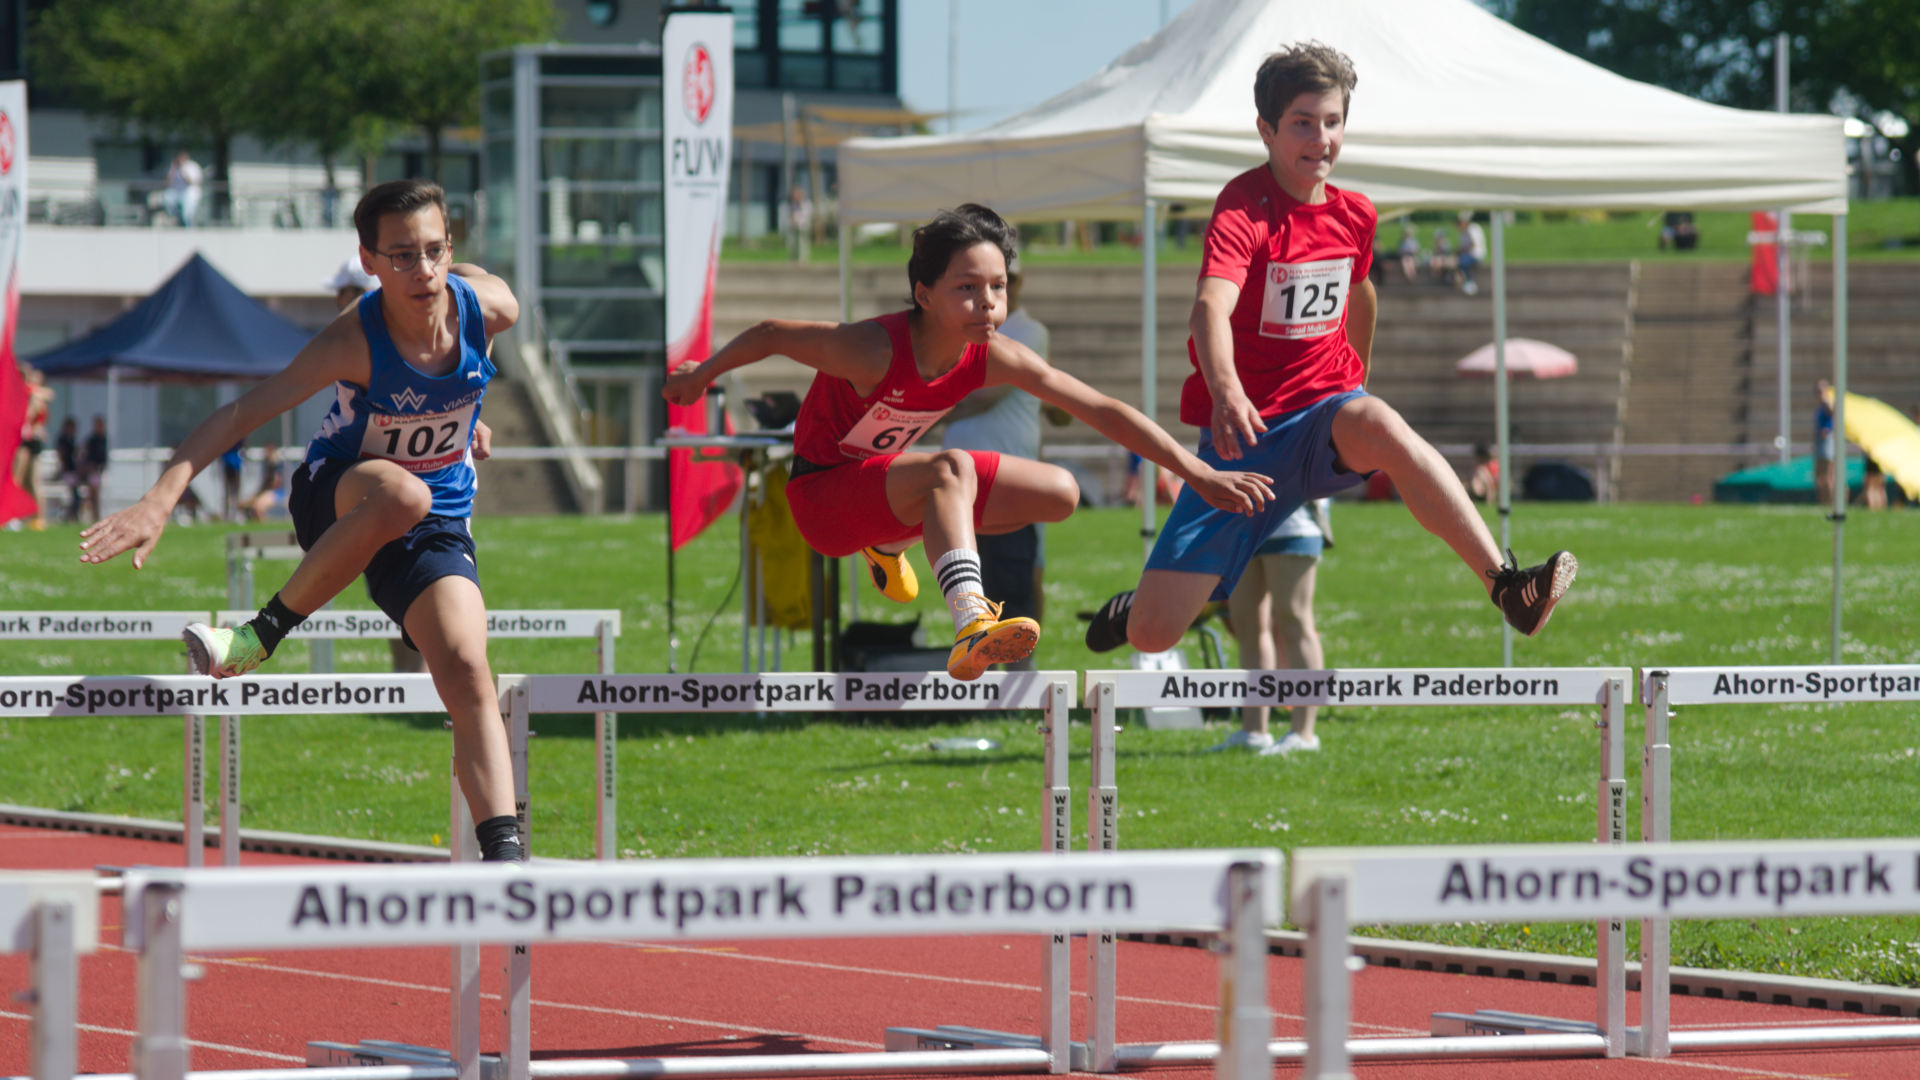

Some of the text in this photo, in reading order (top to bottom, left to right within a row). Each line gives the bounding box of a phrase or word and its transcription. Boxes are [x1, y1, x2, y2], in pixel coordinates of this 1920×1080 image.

[1281, 282, 1339, 320] 125
[383, 421, 458, 457] 102
[872, 426, 921, 450] 61
[39, 616, 153, 633] Paderborn
[487, 616, 566, 632] derborn
[0, 681, 405, 713] orn-Sportpark Paderborn
[577, 677, 1000, 708] Ahorn-Sportpark Paderborn
[1161, 673, 1559, 702] Ahorn-Sportpark Paderborn
[1713, 671, 1920, 699] Ahorn-Sportpar
[1054, 795, 1067, 849] WELLE
[1102, 795, 1113, 849] WELLE
[1611, 786, 1623, 840] WELLE
[1440, 852, 1893, 906] Ahorn-Sportpark
[293, 872, 1134, 933] Ahorn-Sportpark Paderborn
